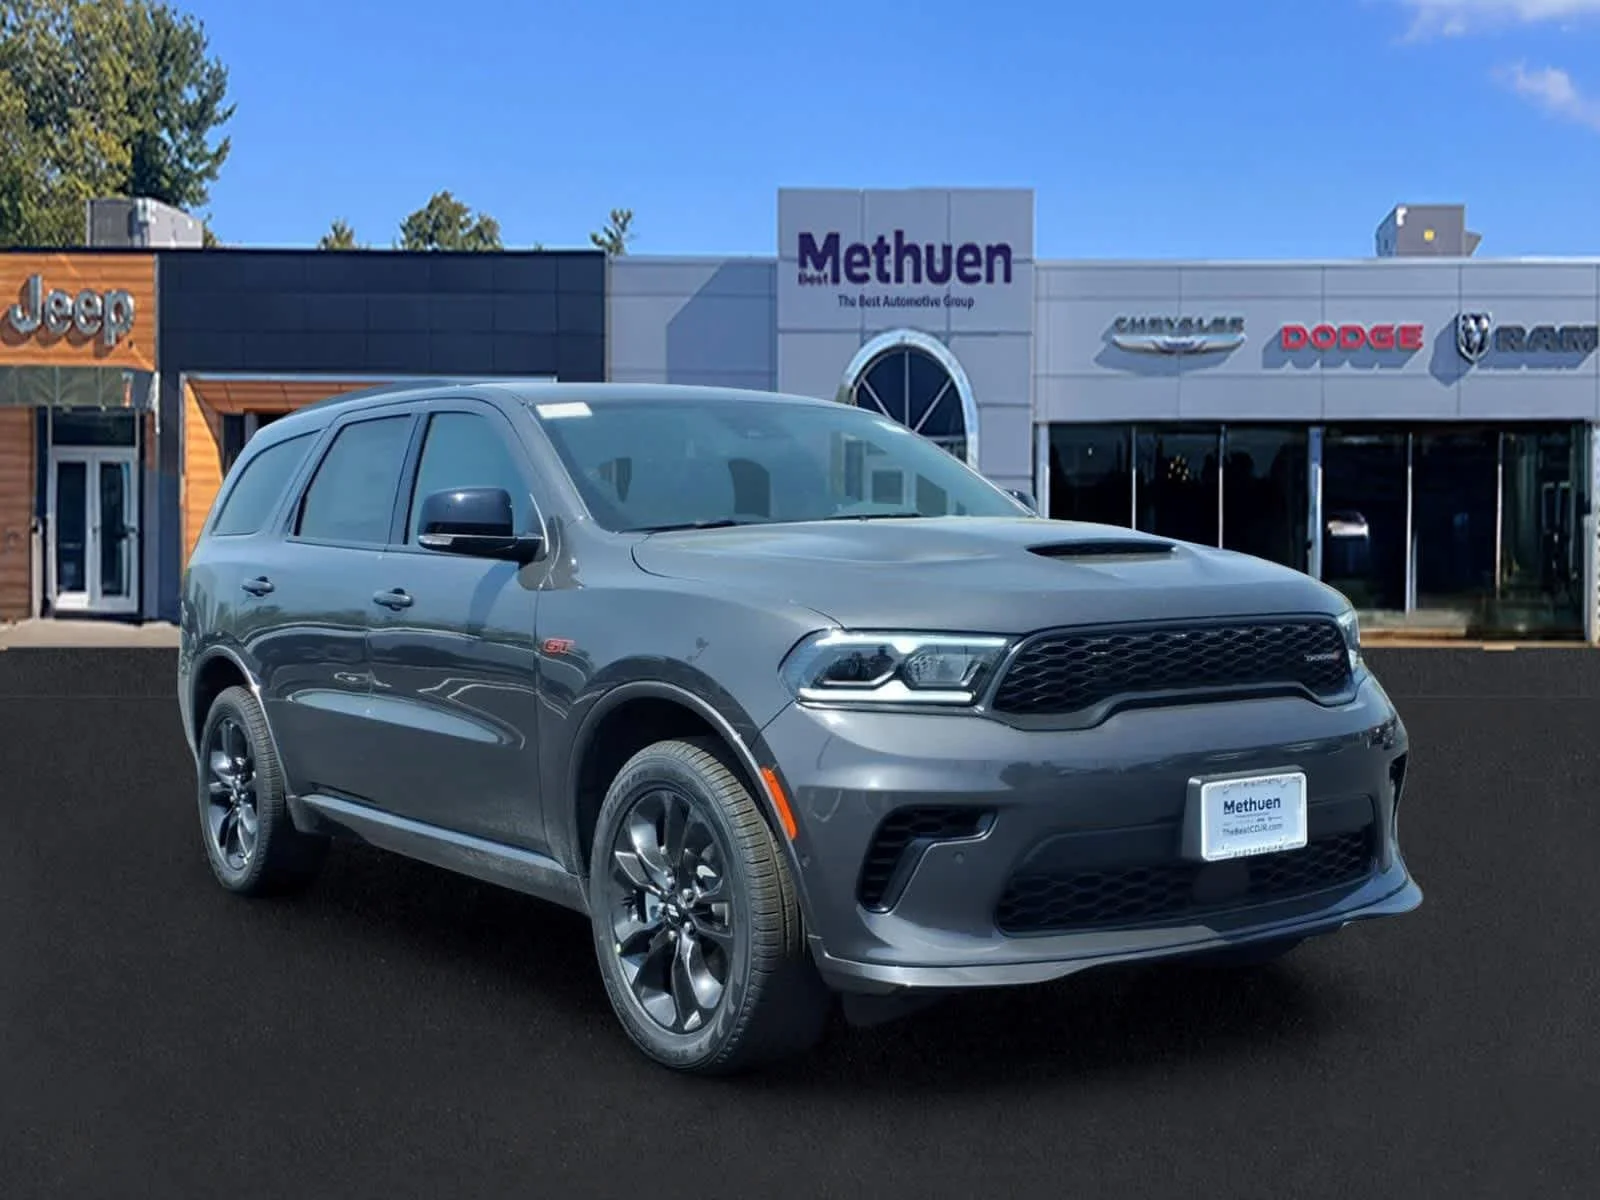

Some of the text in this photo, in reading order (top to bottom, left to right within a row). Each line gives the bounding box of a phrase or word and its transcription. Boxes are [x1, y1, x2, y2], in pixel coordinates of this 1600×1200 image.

[798, 230, 1012, 285] Methuen
[798, 272, 829, 286] Best
[9, 274, 135, 346] Jeep
[838, 295, 975, 311] The Best Automotive Group
[1114, 317, 1245, 333] CHRYSLER
[1282, 324, 1424, 350] DODGE
[1495, 325, 1600, 352] RAM
[1223, 797, 1281, 815] Methuen
